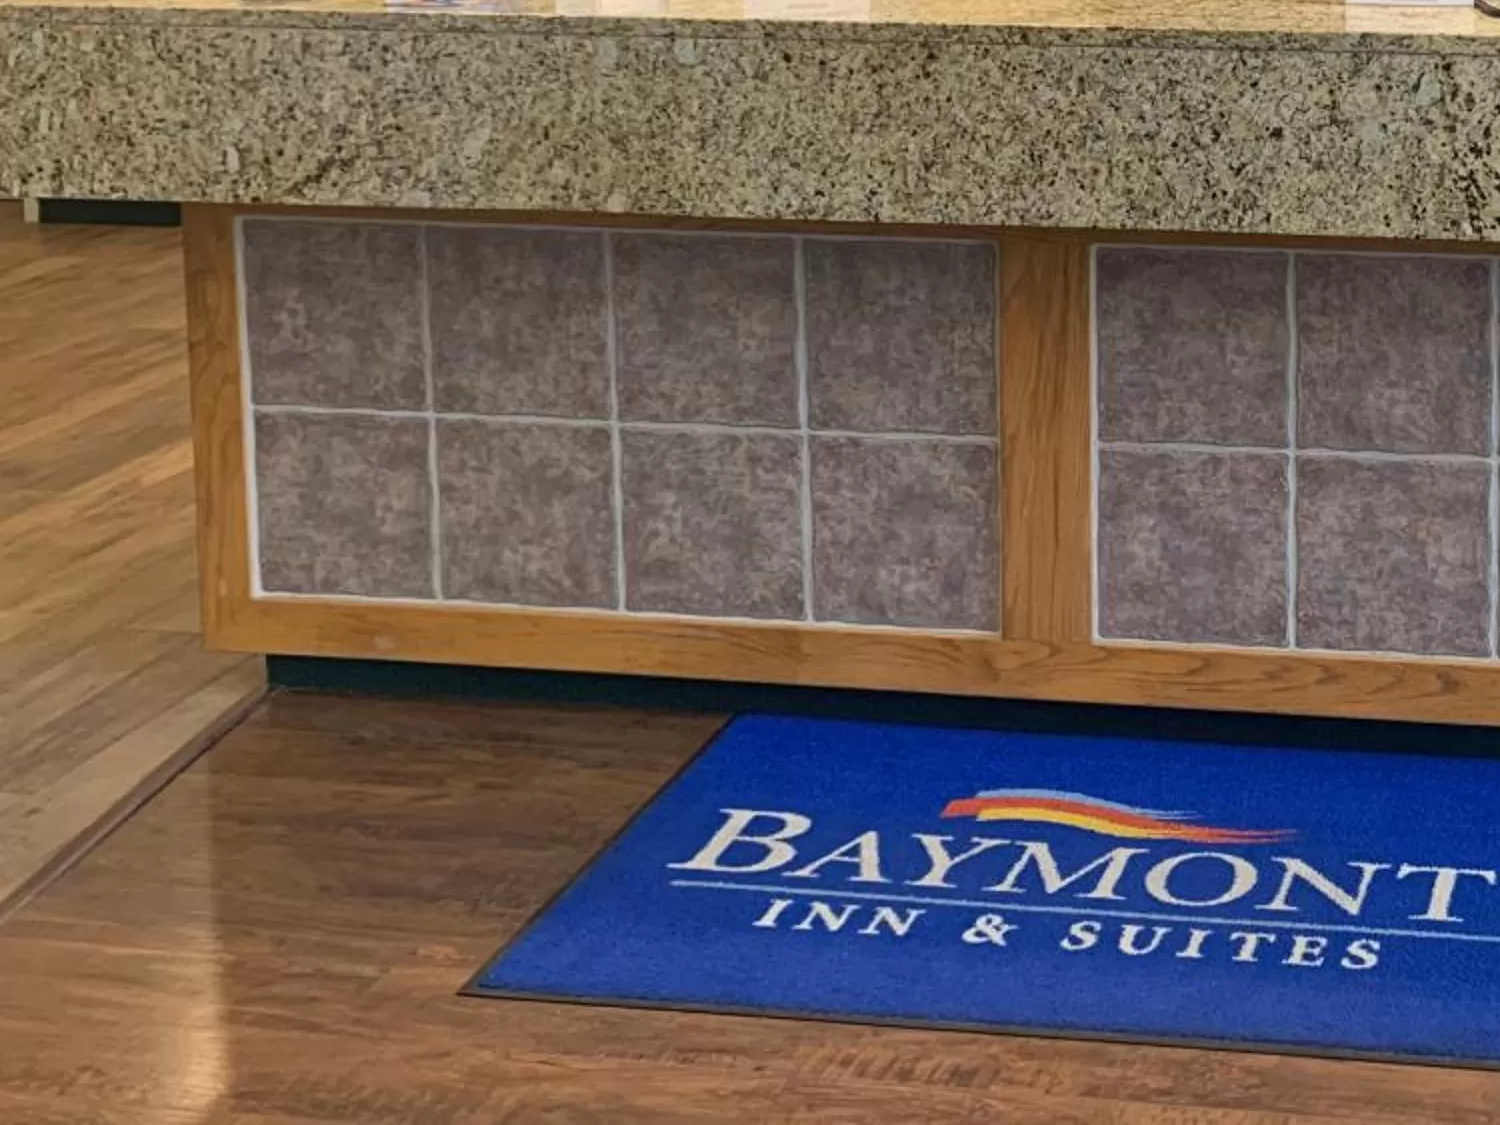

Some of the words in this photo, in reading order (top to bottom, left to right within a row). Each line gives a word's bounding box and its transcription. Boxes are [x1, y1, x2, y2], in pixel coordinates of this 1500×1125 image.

[752, 897, 926, 938] INN
[961, 912, 1019, 947] &
[1060, 920, 1385, 972] SUITES
